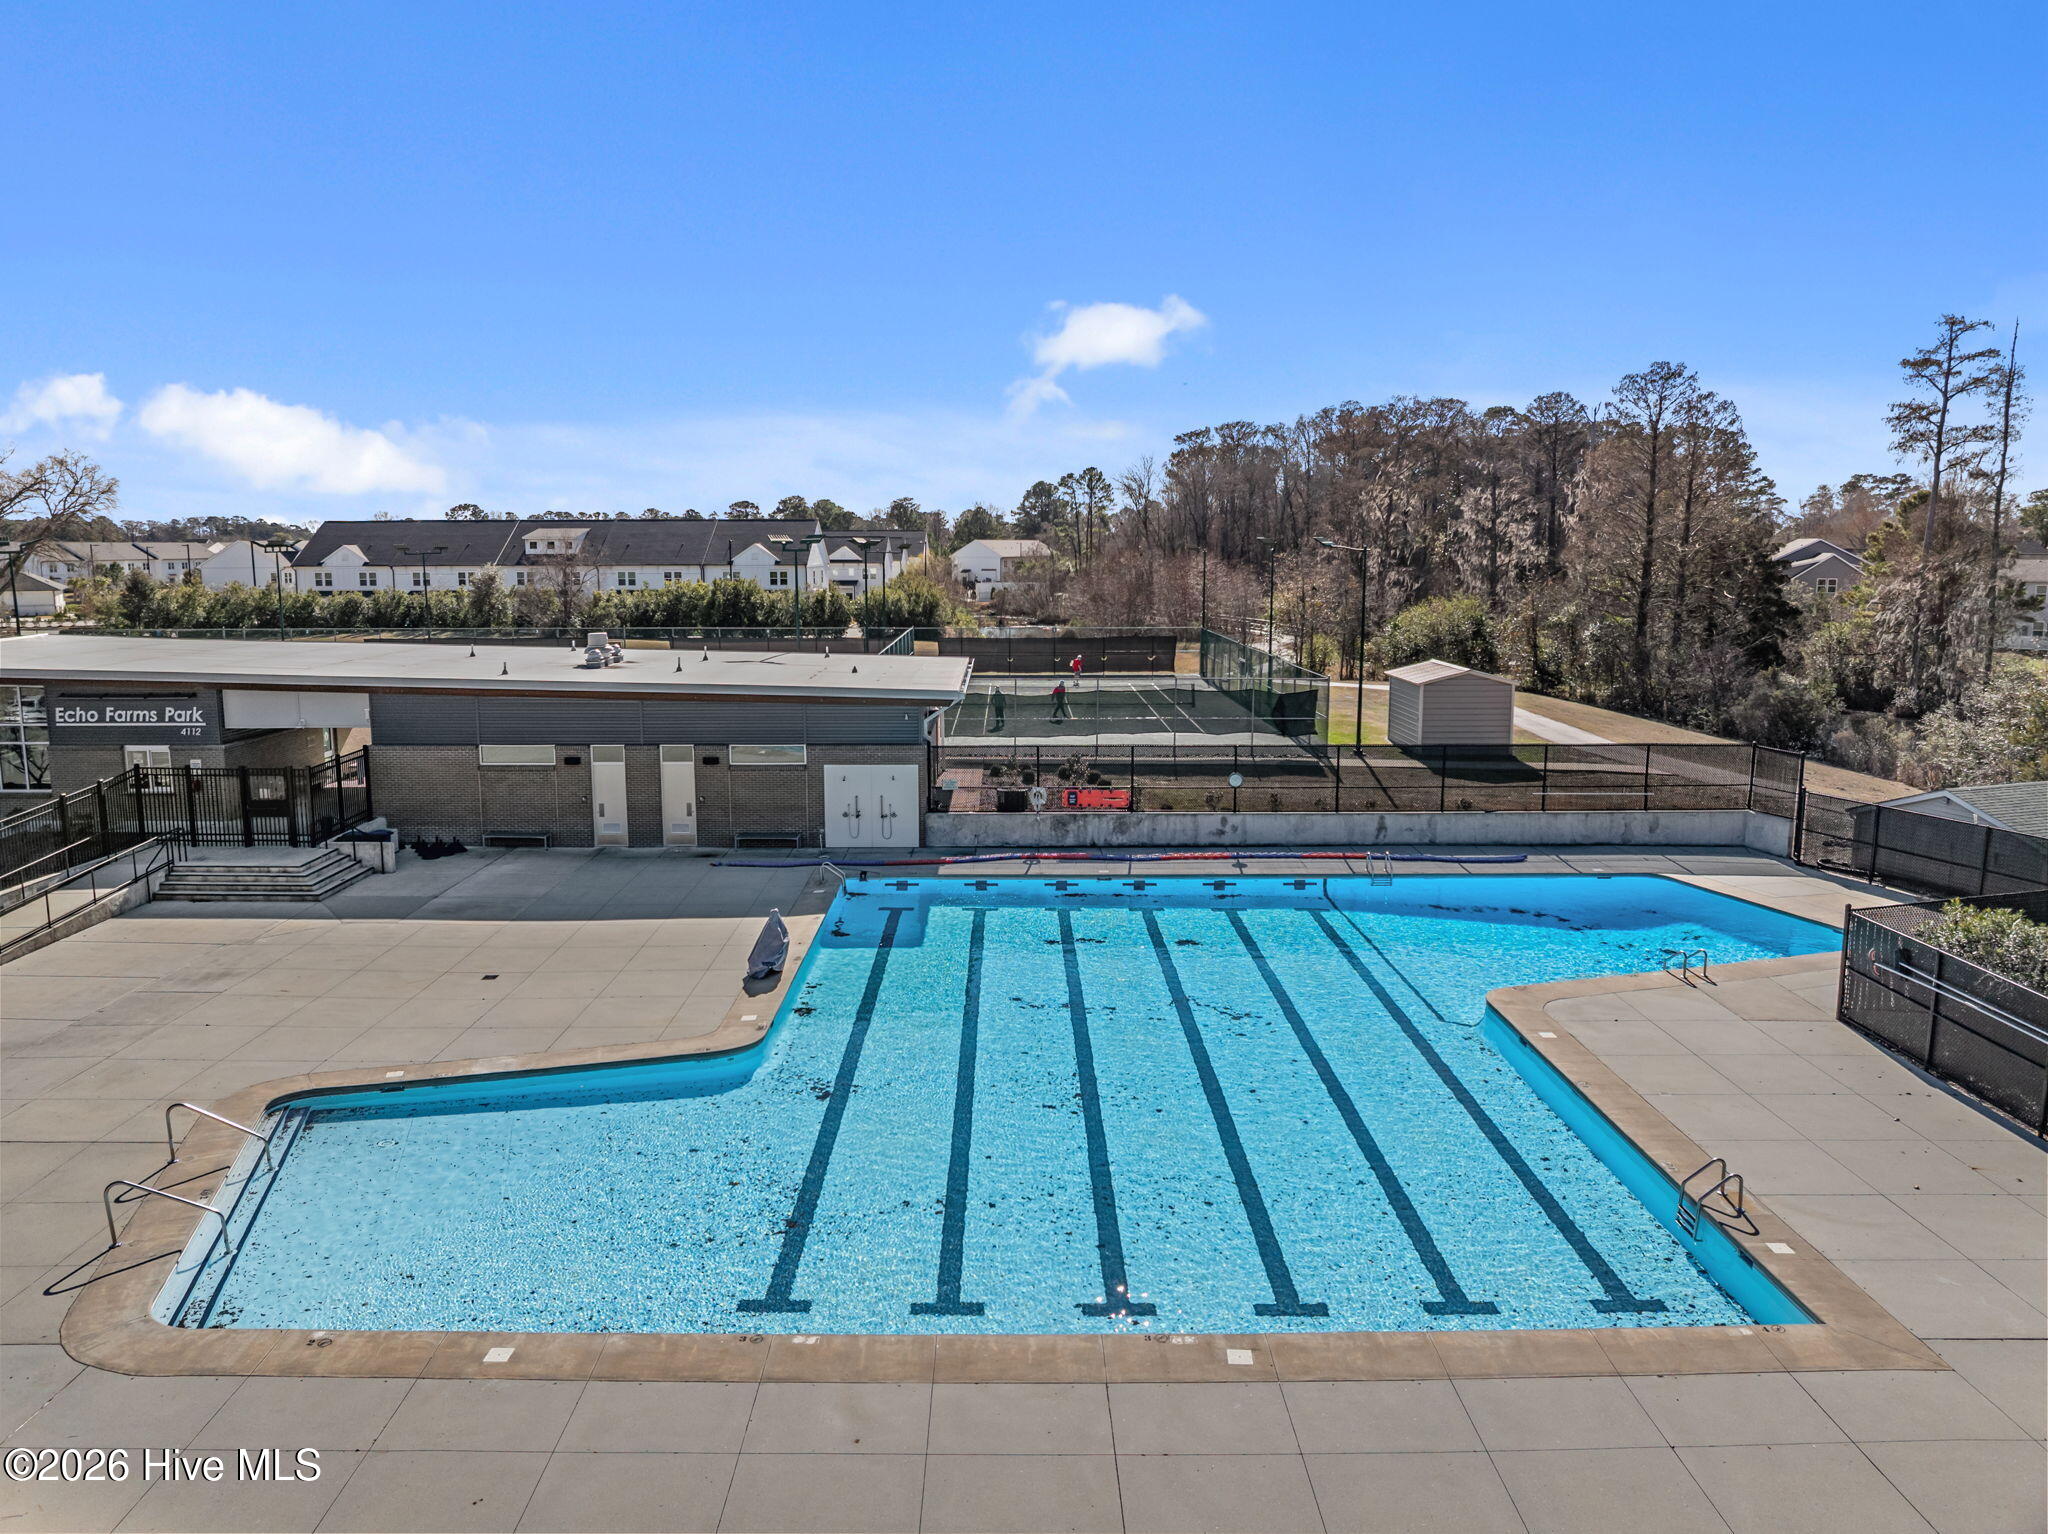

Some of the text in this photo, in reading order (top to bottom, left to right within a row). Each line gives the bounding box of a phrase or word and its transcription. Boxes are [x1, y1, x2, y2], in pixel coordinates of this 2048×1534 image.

[55, 706, 203, 723] Echo Farms Park
[180, 727, 201, 736] 4112
